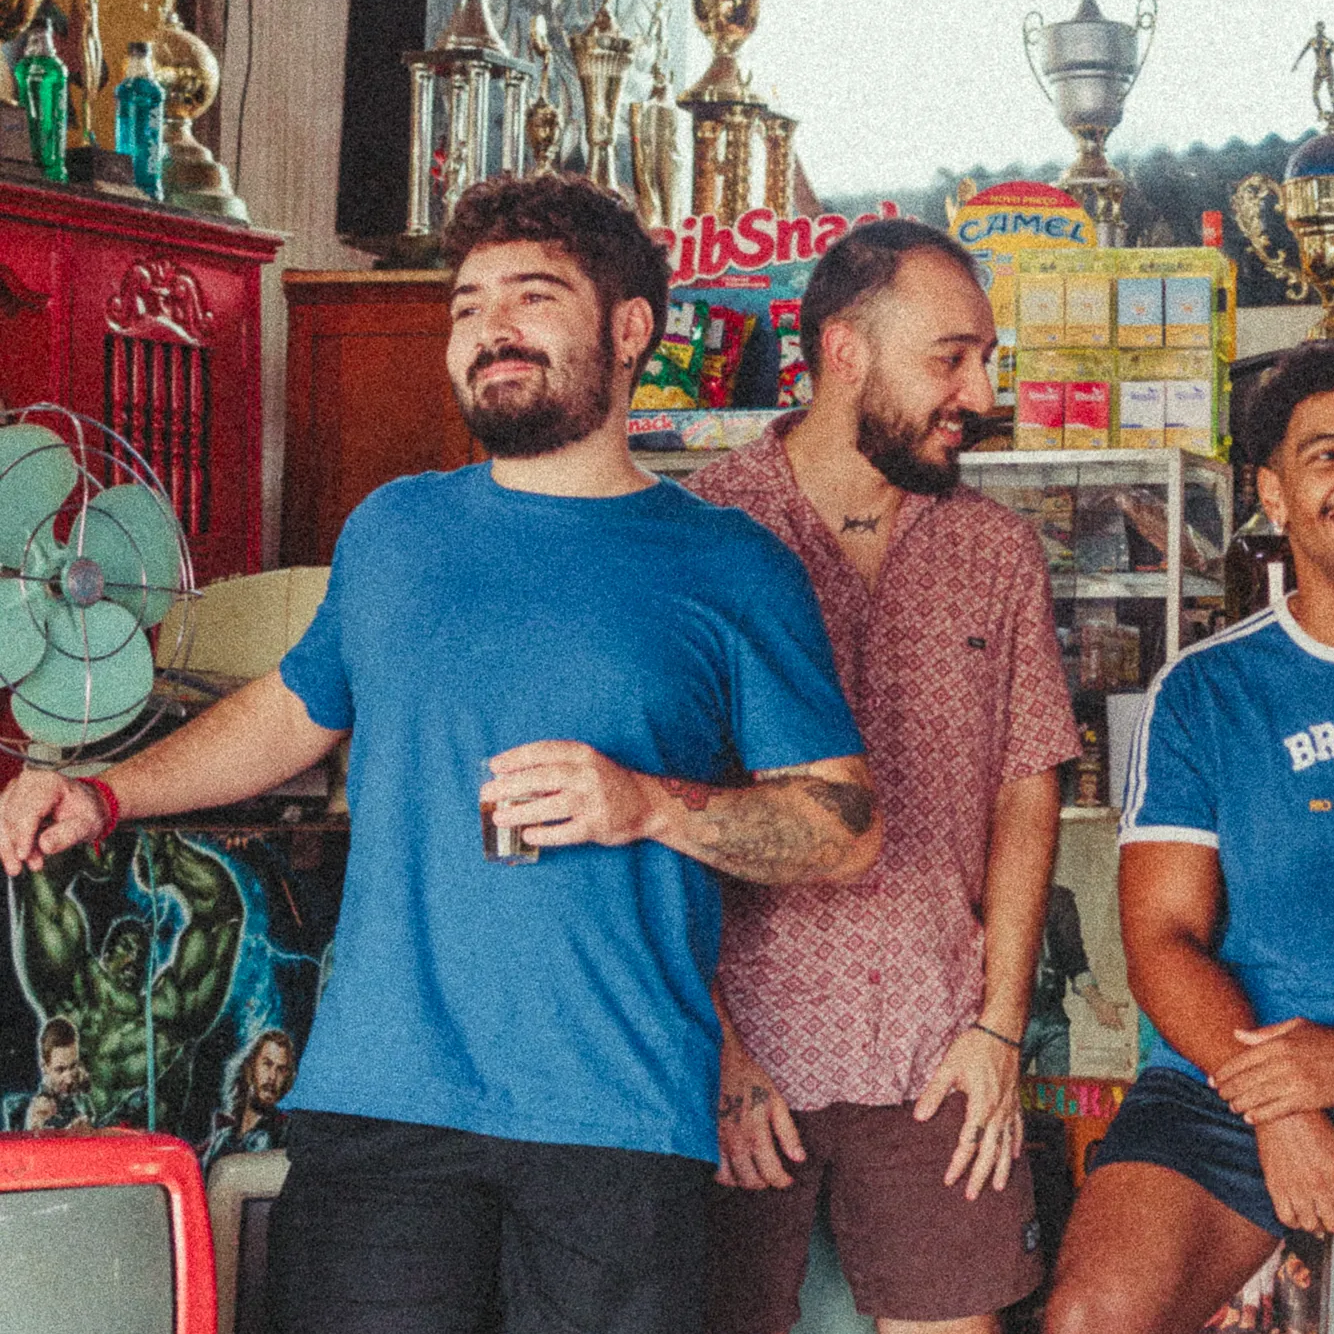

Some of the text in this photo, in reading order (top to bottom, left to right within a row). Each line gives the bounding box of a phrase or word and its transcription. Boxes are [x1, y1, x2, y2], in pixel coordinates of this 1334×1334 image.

[989, 195, 1021, 204] NOVO
[957, 211, 1088, 245] CAMEL
[1309, 799, 1331, 812] RIO
